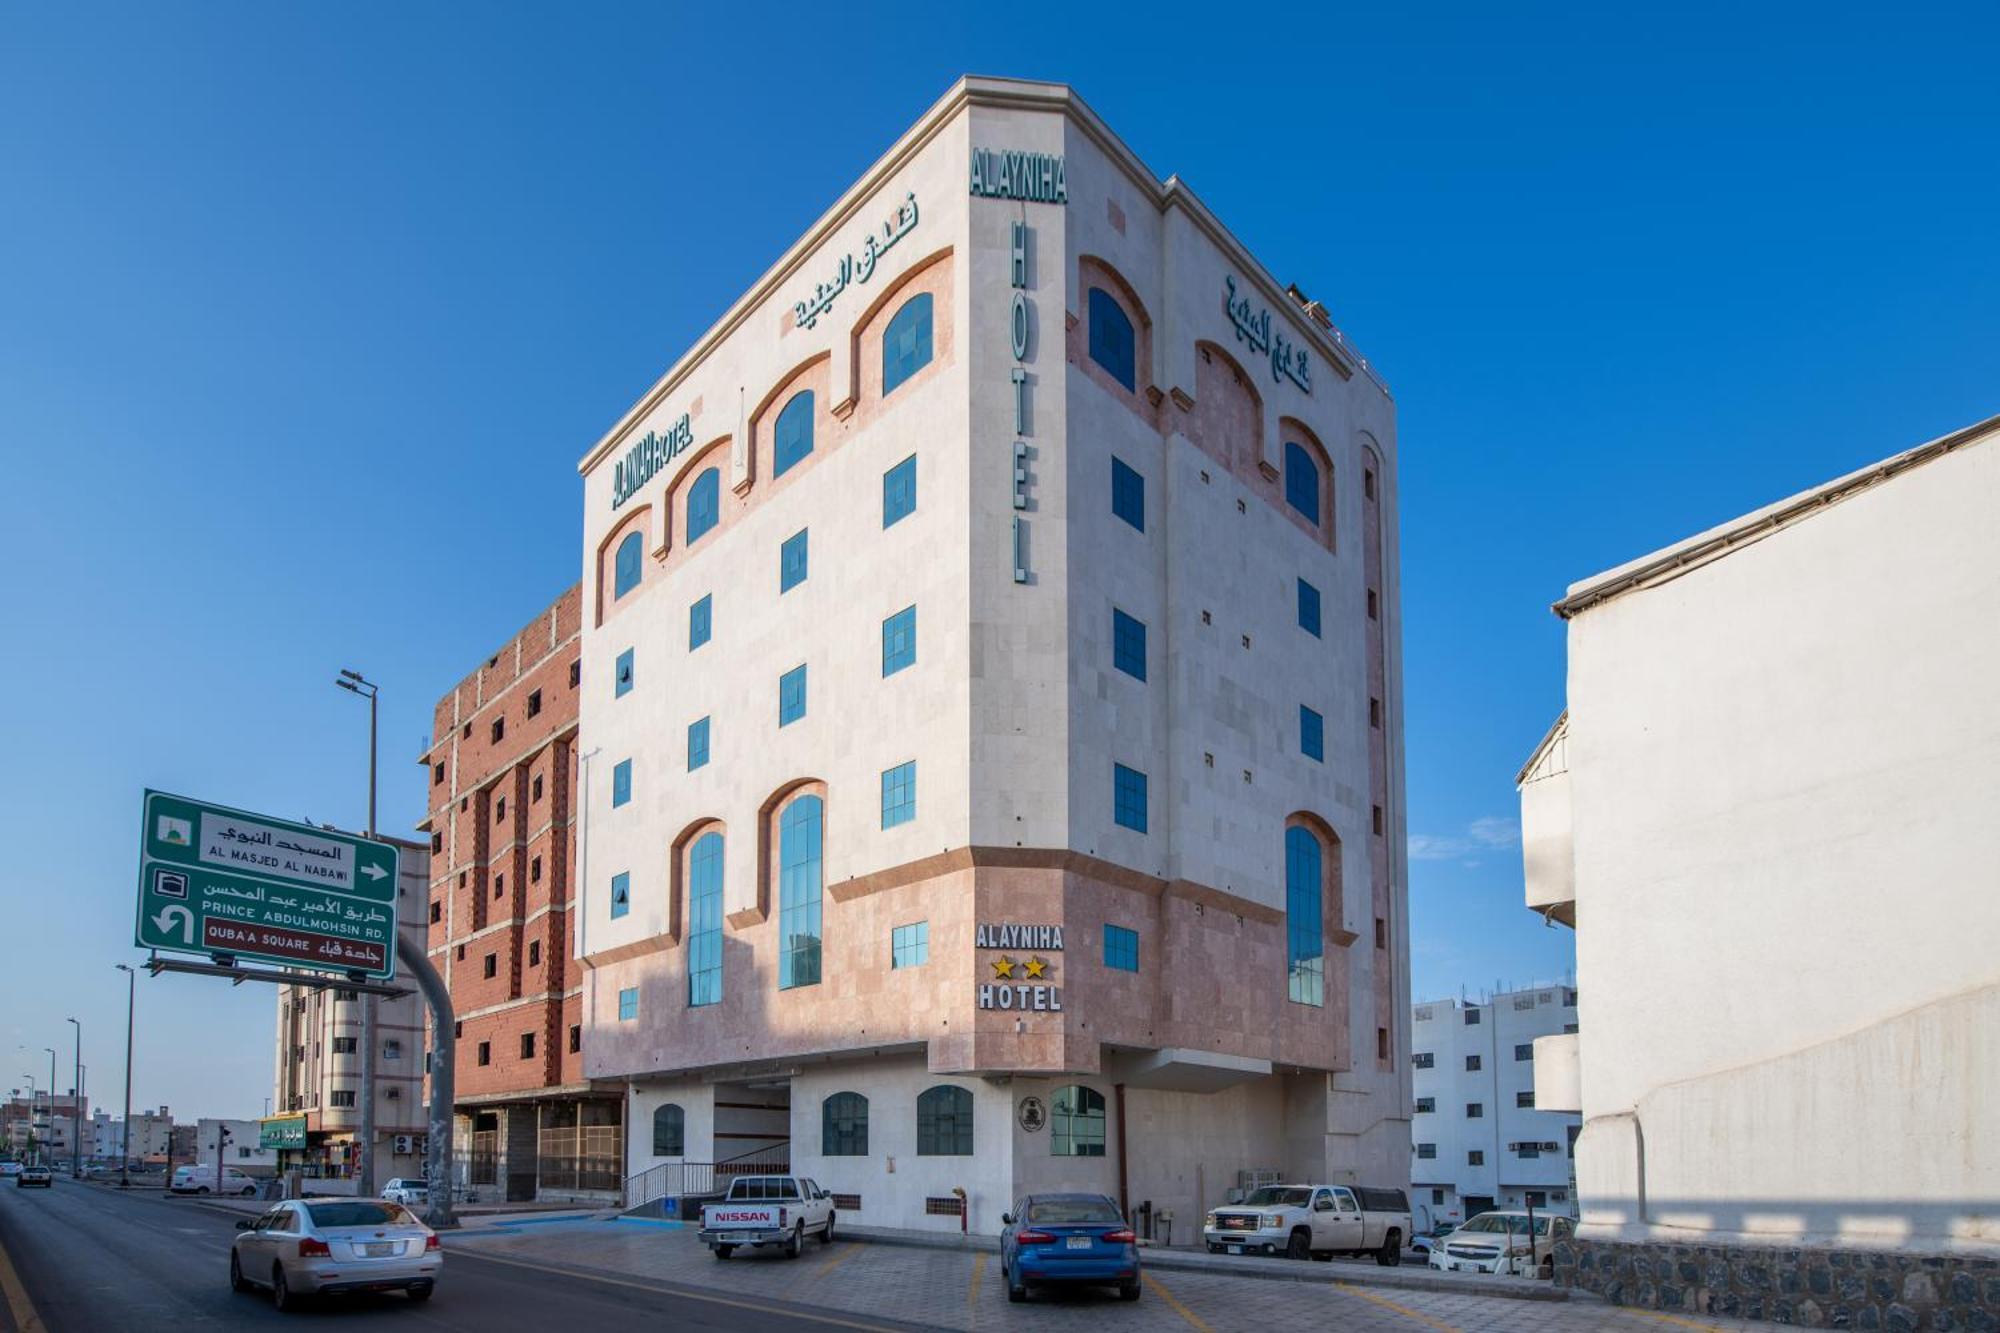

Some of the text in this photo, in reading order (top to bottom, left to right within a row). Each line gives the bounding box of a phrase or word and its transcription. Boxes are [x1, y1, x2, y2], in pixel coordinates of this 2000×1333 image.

[969, 147, 1068, 203] ALAYNIHA
[856, 191, 919, 284] فندق
[1011, 220, 1027, 584] HOTEL
[654, 412, 694, 474] HOTEL
[218, 828, 341, 860] المسجد النبوي
[209, 846, 348, 881] AL MASJED AL NABAWI
[203, 884, 265, 901] المحسن
[269, 895, 298, 909] عبد
[202, 900, 385, 939] PRINCE ABDULMOHSIN RD.
[344, 906, 386, 922] طريق
[262, 934, 310, 950] SQUARE
[319, 940, 343, 957] قباء
[976, 924, 1064, 950] ALAYNIHA
[979, 984, 1062, 1011] HOTEL
[715, 1212, 770, 1222] NISSAN
